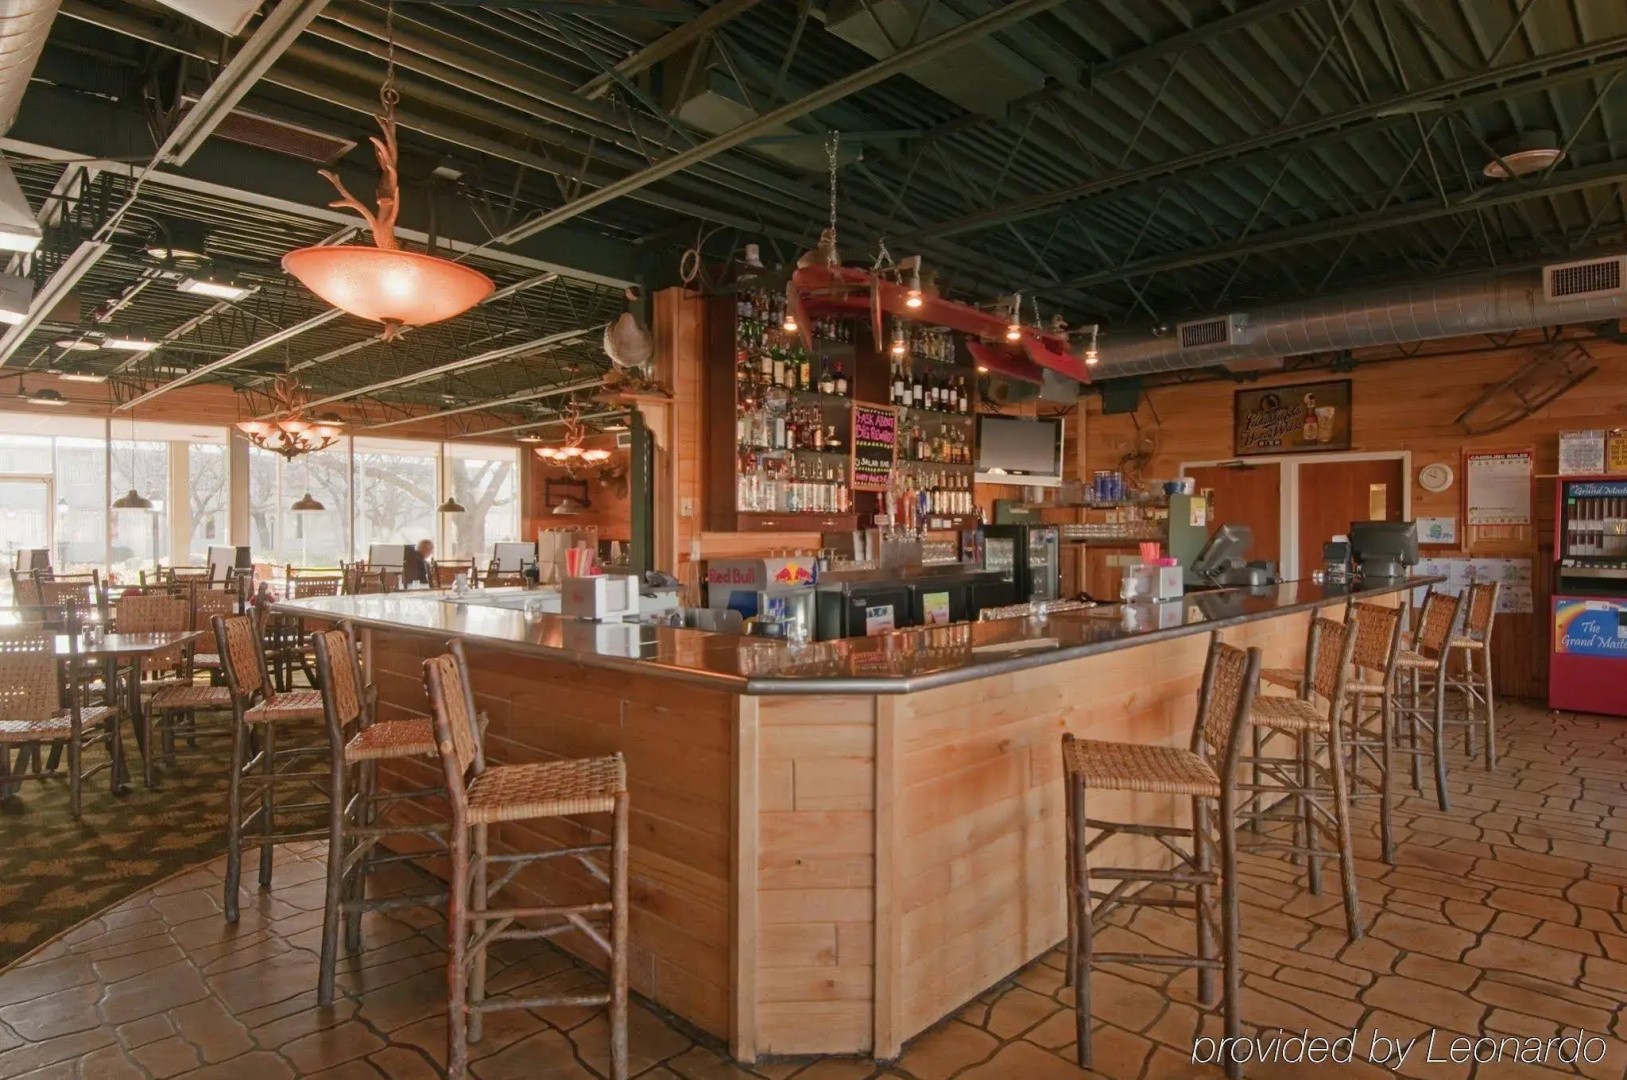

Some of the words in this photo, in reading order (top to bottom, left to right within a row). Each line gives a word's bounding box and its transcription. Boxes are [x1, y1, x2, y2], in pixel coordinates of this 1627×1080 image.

[1574, 485, 1603, 496] Grand
[708, 567, 731, 584] Red
[733, 567, 755, 584] Bull
[1581, 620, 1601, 633] The
[1561, 634, 1597, 647] Grand
